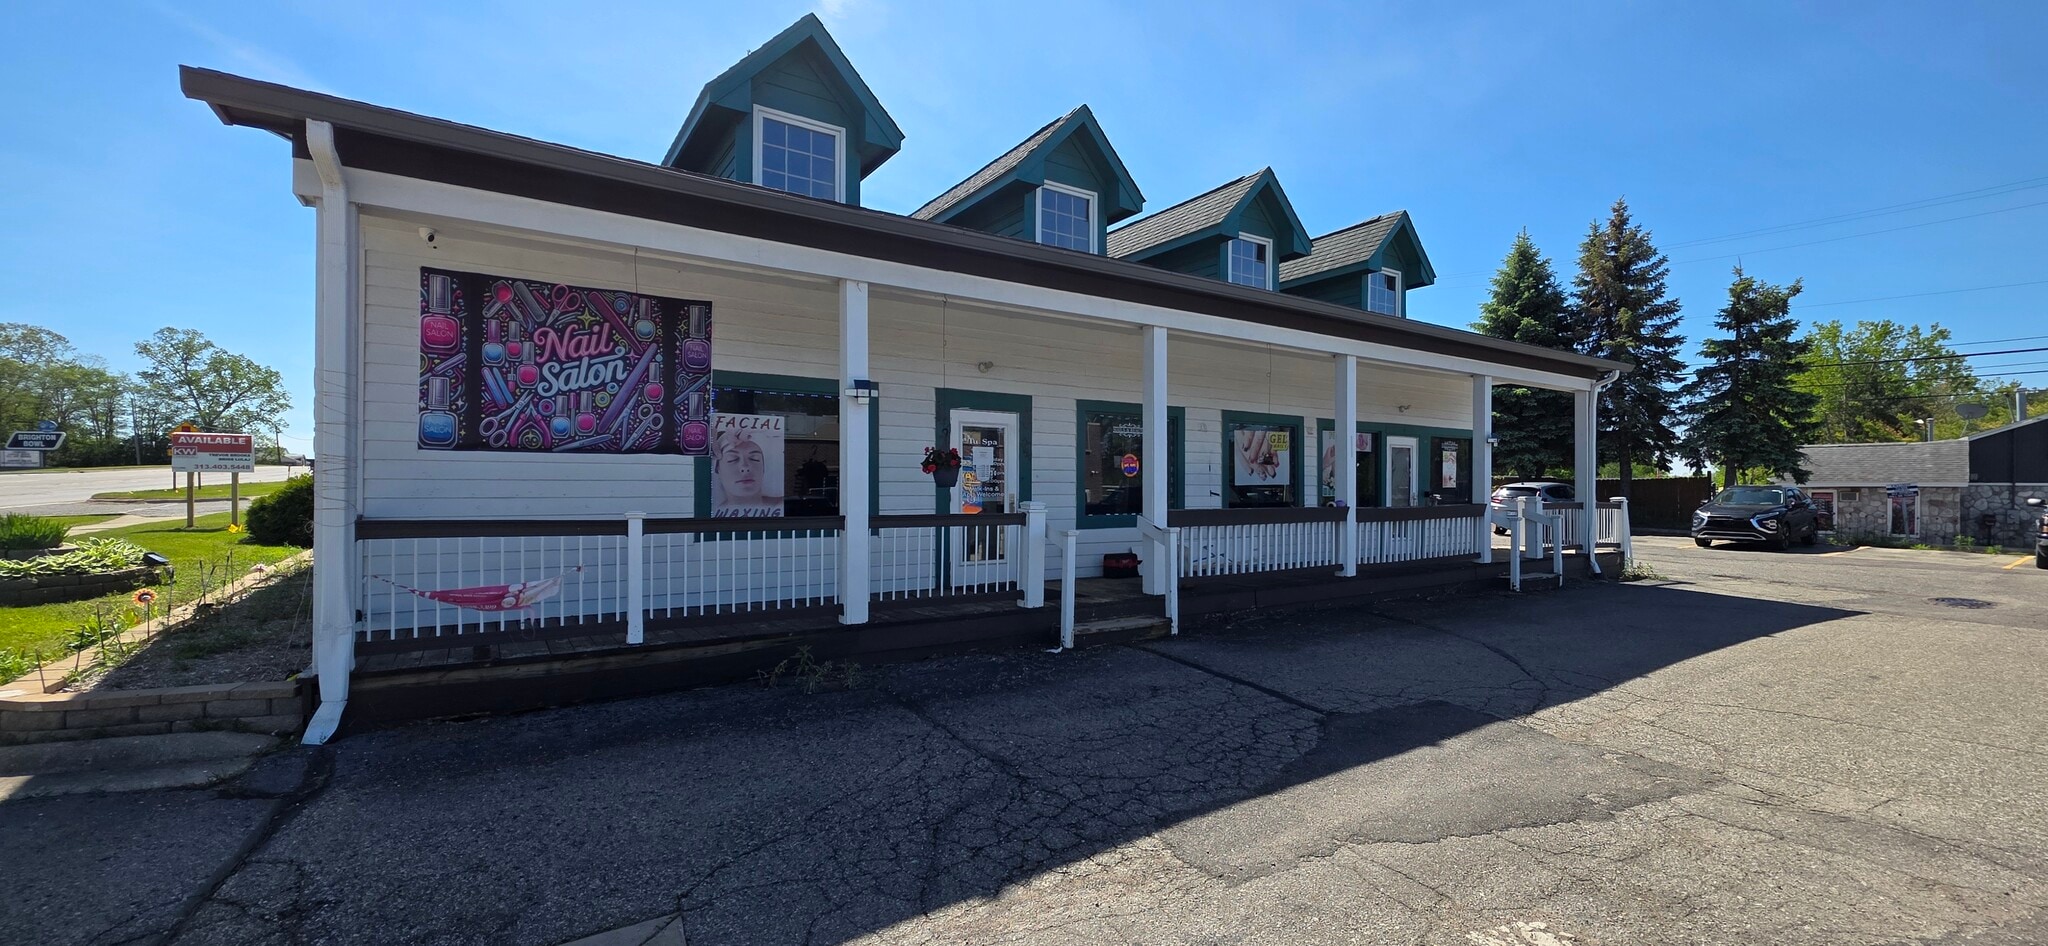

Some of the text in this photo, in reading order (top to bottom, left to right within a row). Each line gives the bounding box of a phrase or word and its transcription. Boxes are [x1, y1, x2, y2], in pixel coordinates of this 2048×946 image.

[430, 321, 449, 330] NAIL
[426, 328, 454, 338] SALON
[533, 322, 614, 362] Nail
[537, 355, 629, 397] Salon
[715, 416, 782, 430] FACIAL
[424, 424, 452, 434] SALON
[178, 436, 246, 445] AVAILABLE
[982, 438, 998, 446] Spa
[1270, 434, 1287, 444] GEL
[715, 508, 782, 517] WAXING
